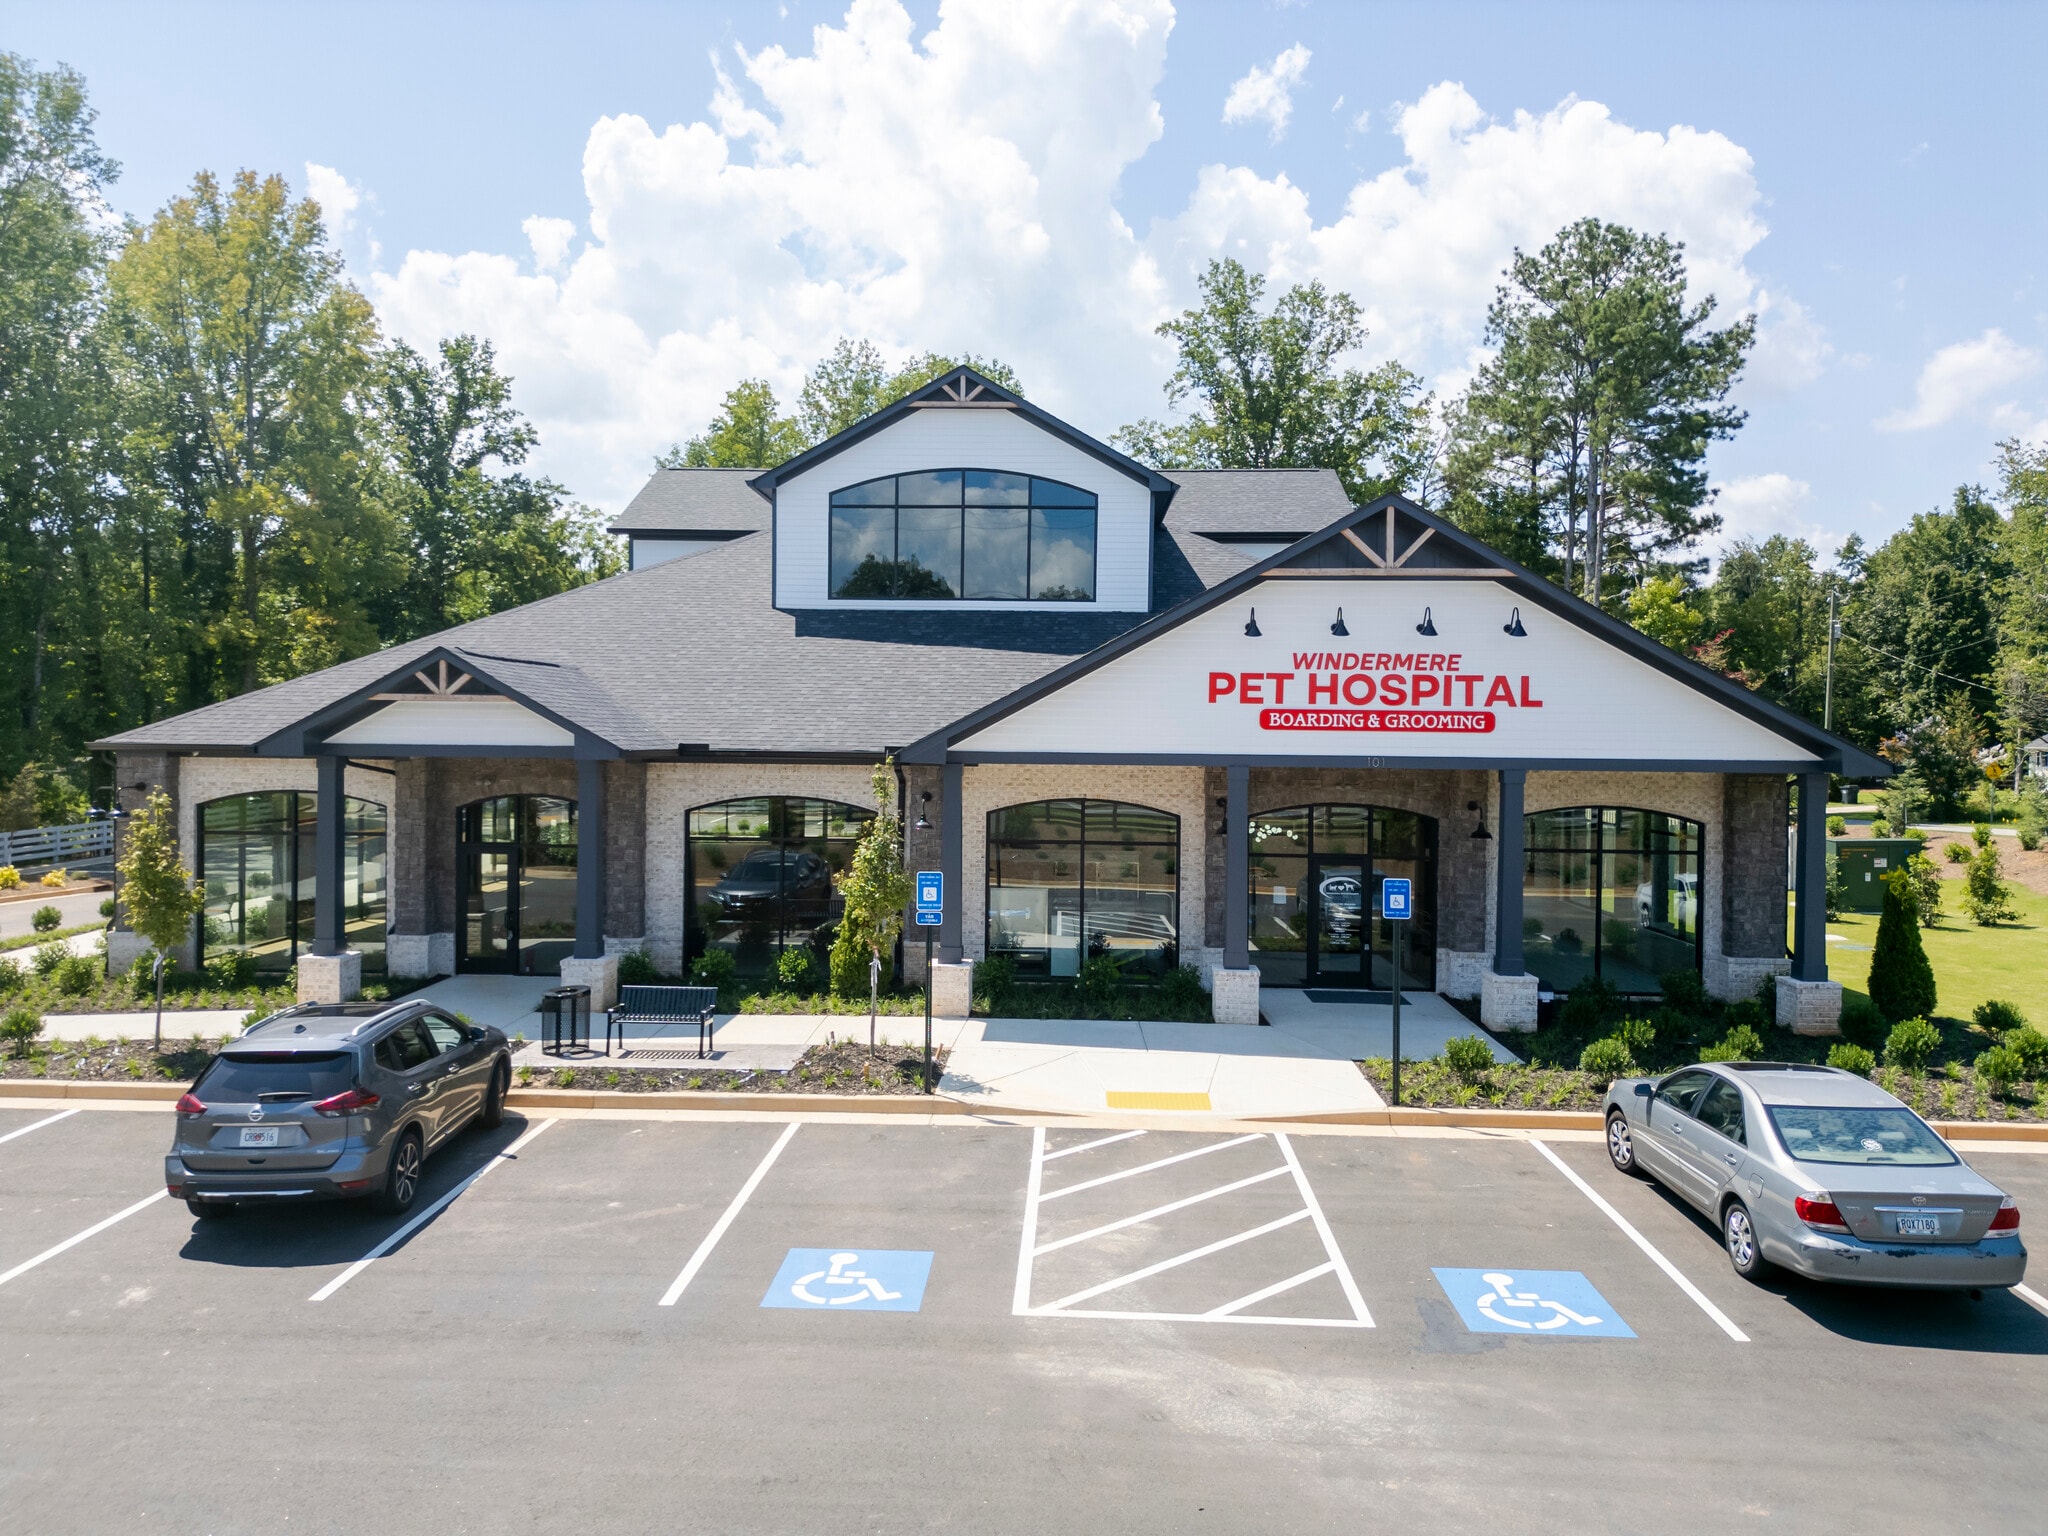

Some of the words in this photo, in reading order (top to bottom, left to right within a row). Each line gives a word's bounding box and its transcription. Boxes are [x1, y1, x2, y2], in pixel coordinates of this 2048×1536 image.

[1293, 652, 1462, 672] WINDERMERE
[1208, 672, 1294, 704] PET
[1308, 673, 1543, 708] HOSPITAL
[1269, 712, 1364, 728] BOARDING
[1367, 713, 1381, 728] &
[1385, 714, 1486, 730] GROOMING
[1367, 757, 1385, 768] 101
